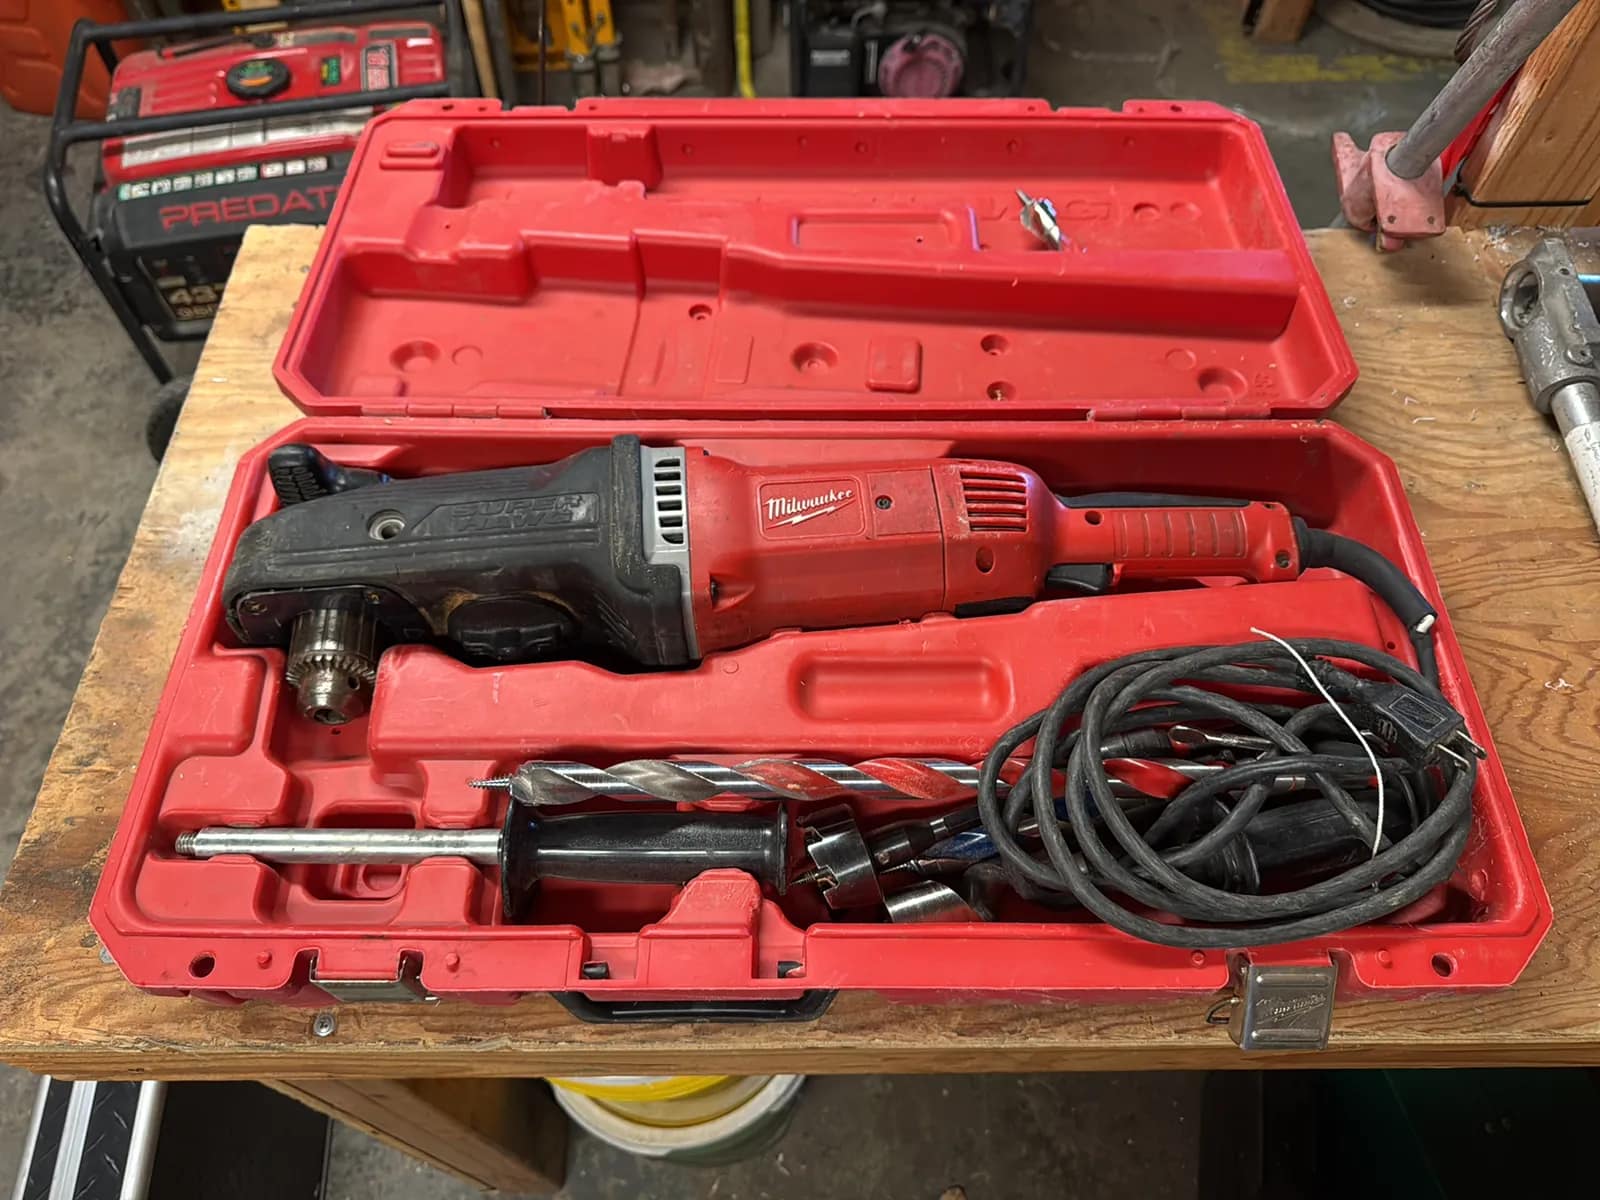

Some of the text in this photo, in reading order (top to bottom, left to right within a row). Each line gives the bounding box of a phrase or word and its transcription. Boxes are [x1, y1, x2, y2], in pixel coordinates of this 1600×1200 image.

[160, 184, 344, 231] PREDAT
[451, 494, 584, 518] SUPER
[763, 488, 853, 521] Milwaukee
